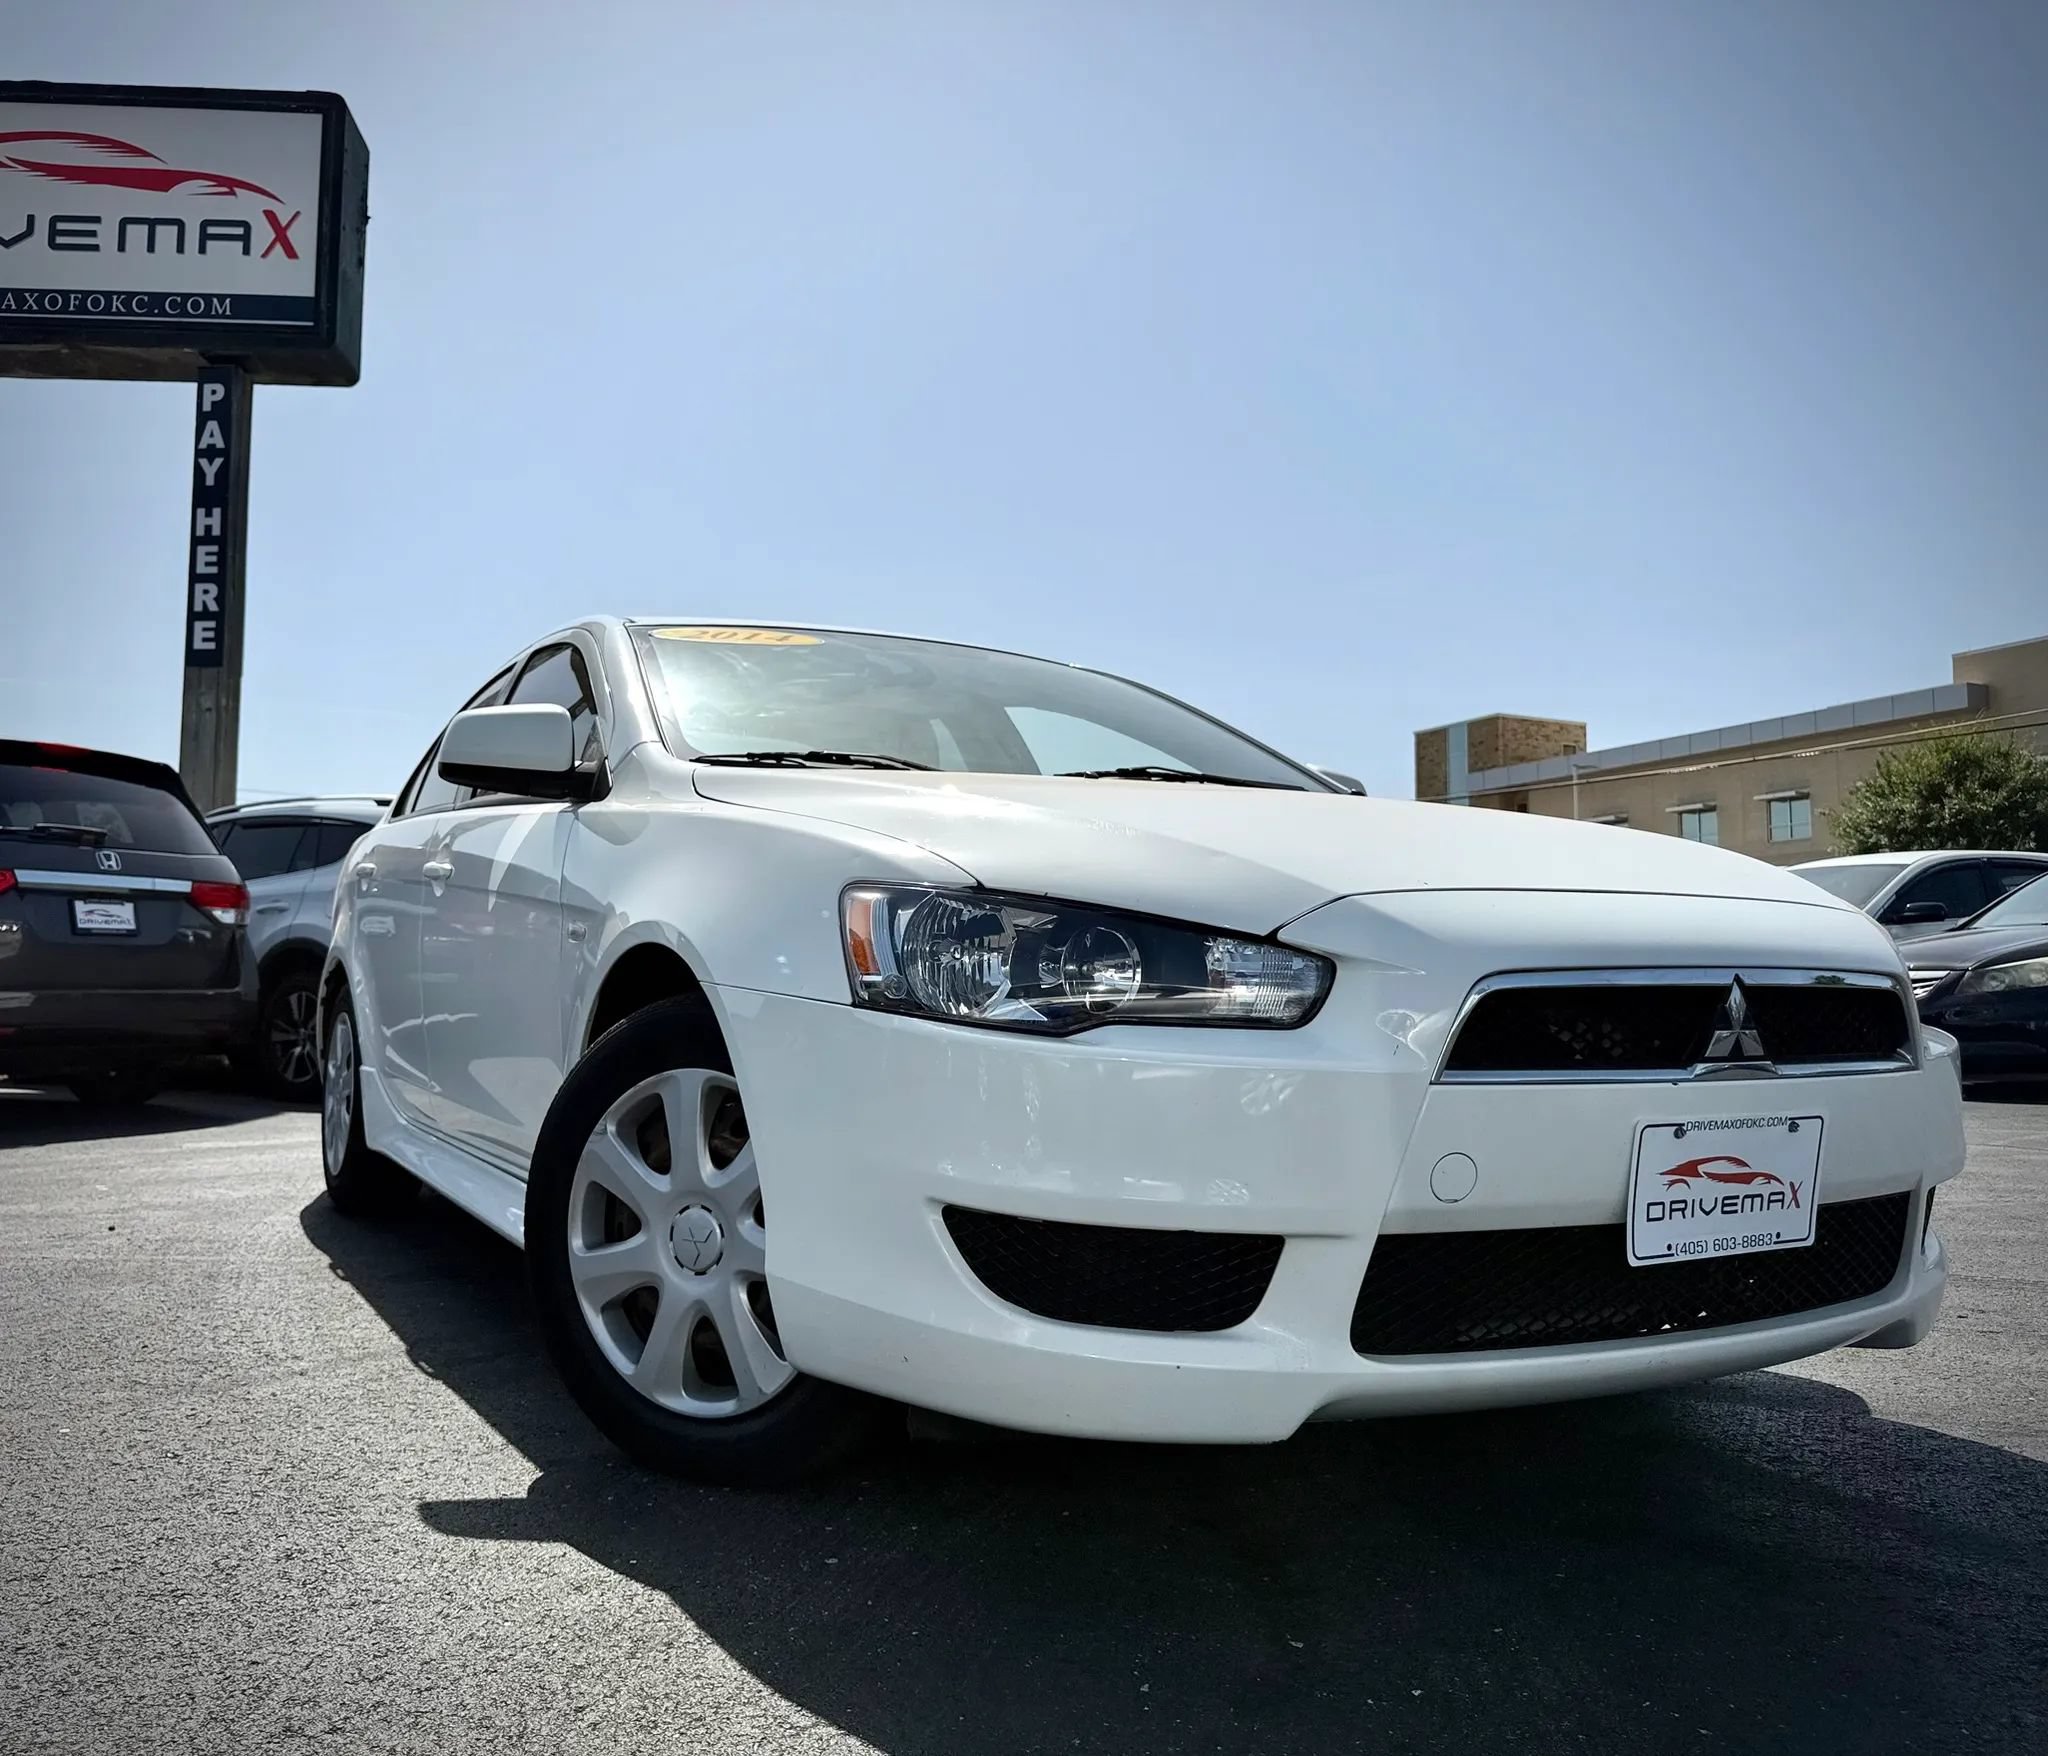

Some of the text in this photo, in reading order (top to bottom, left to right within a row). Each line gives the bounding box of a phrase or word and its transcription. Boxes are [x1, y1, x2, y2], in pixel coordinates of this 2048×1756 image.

[0, 209, 301, 260] VEMAX
[1, 291, 232, 316] AXOFOKC.COM
[192, 383, 226, 650] PAY HERE
[680, 630, 793, 642] 2014
[1685, 1116, 1789, 1132] DRIVEMAXOFOKC.COM
[1646, 1181, 1803, 1222] DRIVEMAX
[1675, 1233, 1773, 1256] (405) 603-8883
